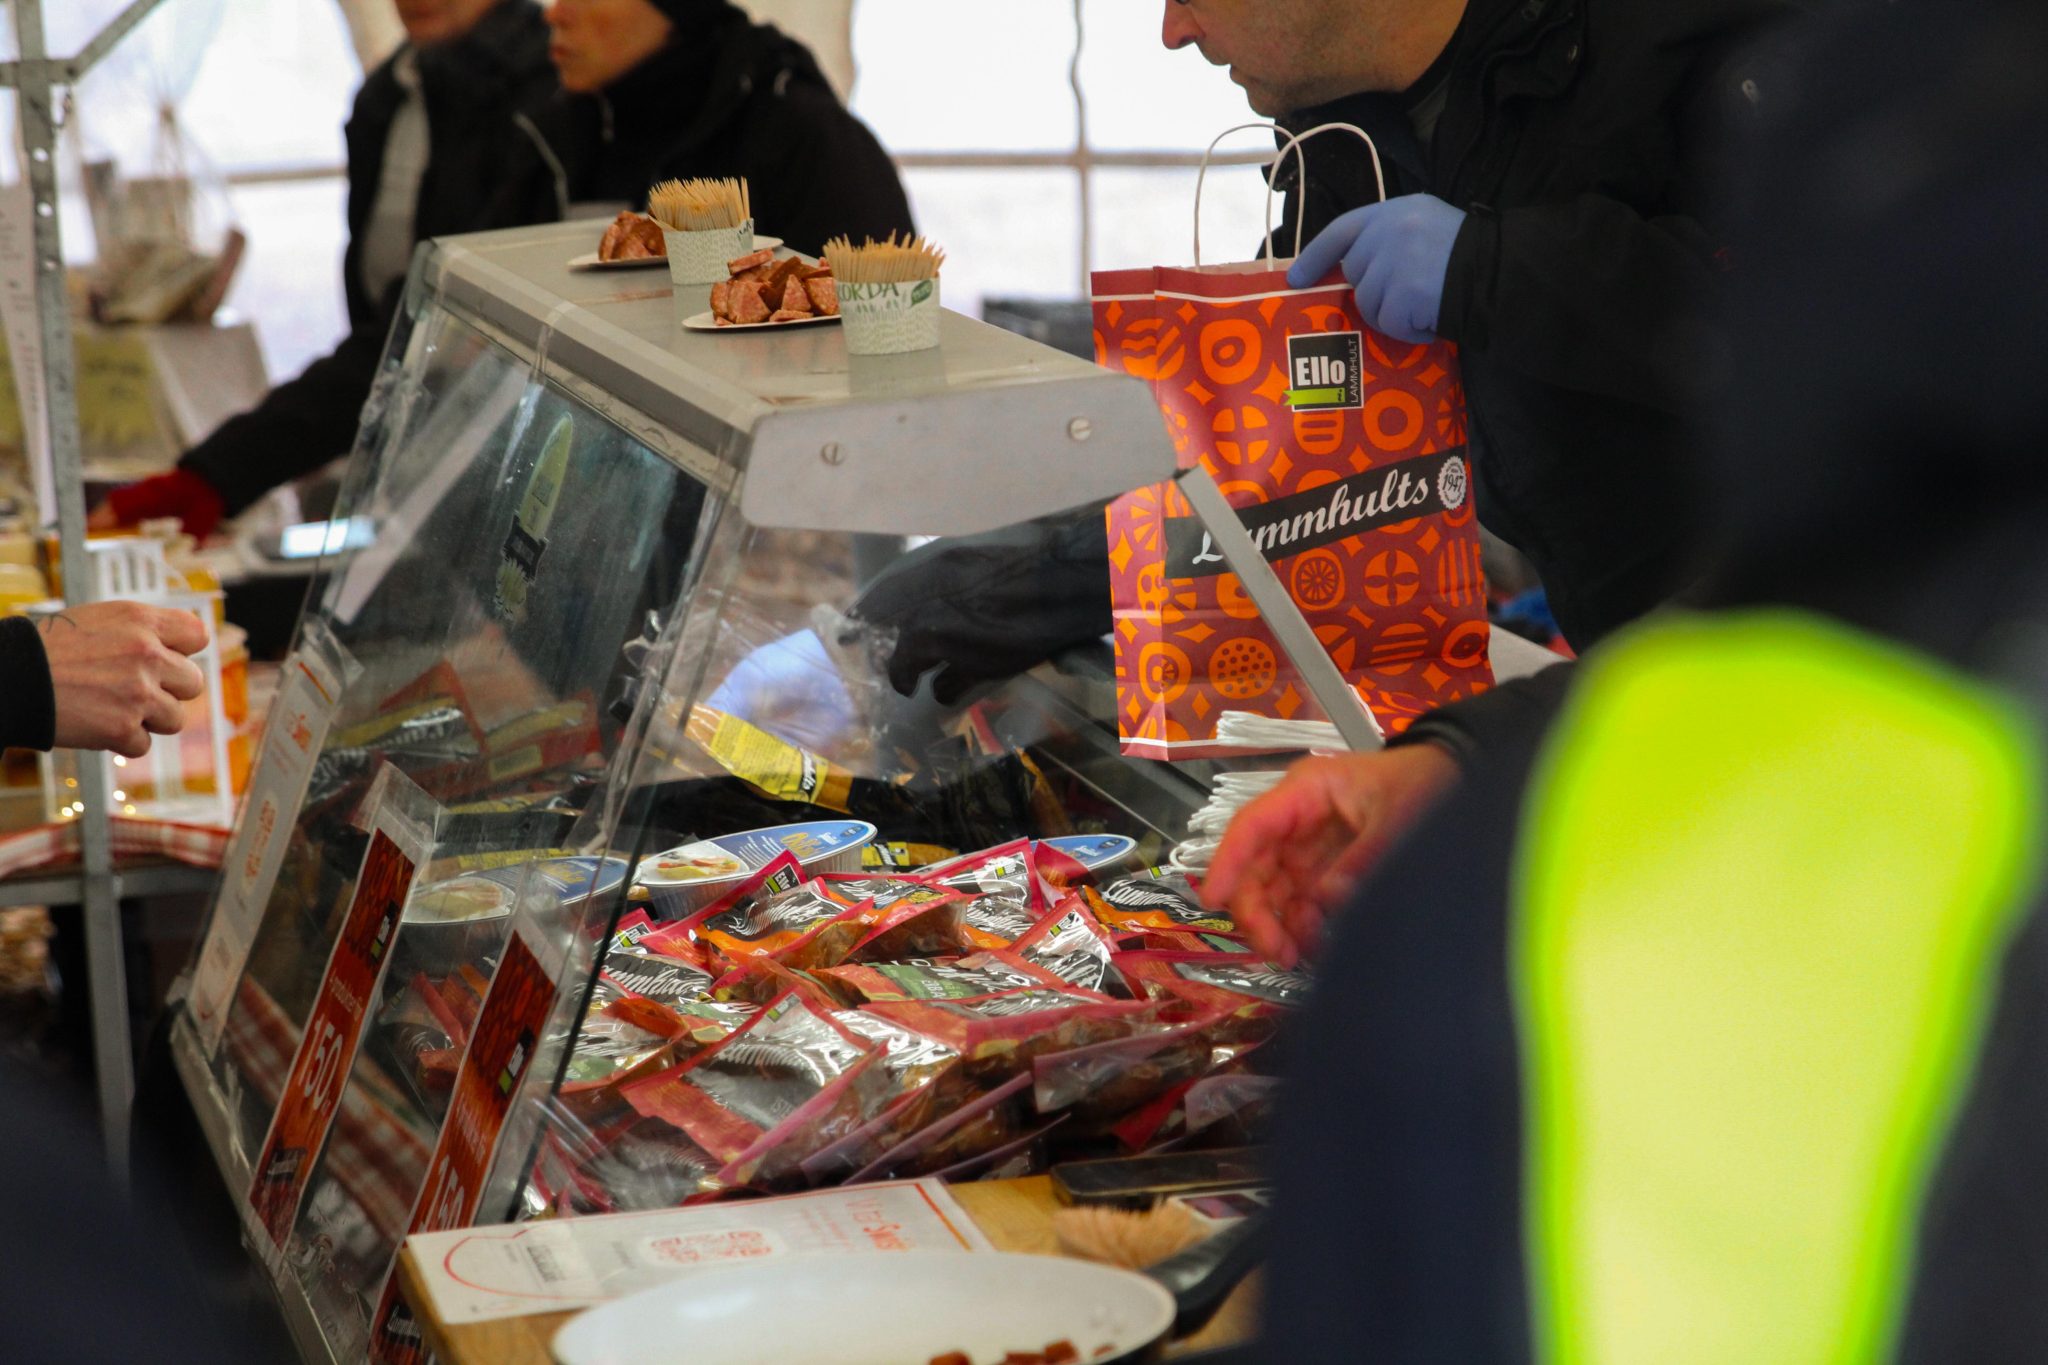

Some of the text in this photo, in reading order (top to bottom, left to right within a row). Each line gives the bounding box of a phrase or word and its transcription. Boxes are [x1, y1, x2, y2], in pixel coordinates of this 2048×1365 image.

[1295, 355, 1346, 387] Ello
[1348, 339, 1359, 403] LAMMHULT
[1192, 468, 1429, 565] Lmmhults
[1442, 473, 1464, 493] 1947
[298, 1013, 343, 1111] 150
